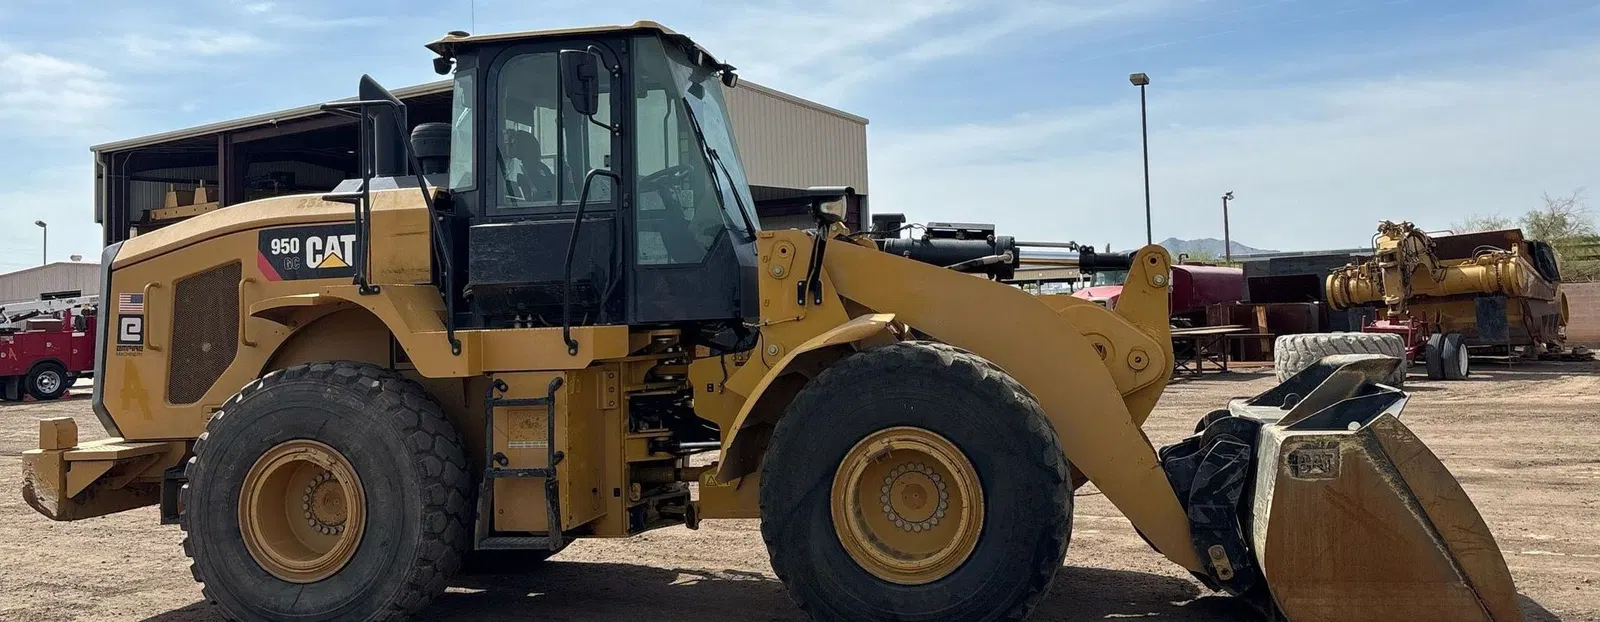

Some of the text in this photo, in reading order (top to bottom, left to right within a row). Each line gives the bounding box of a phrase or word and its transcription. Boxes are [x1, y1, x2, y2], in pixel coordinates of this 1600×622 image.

[271, 237, 300, 255] 950
[306, 234, 356, 269] CAT
[284, 256, 301, 270] GC
